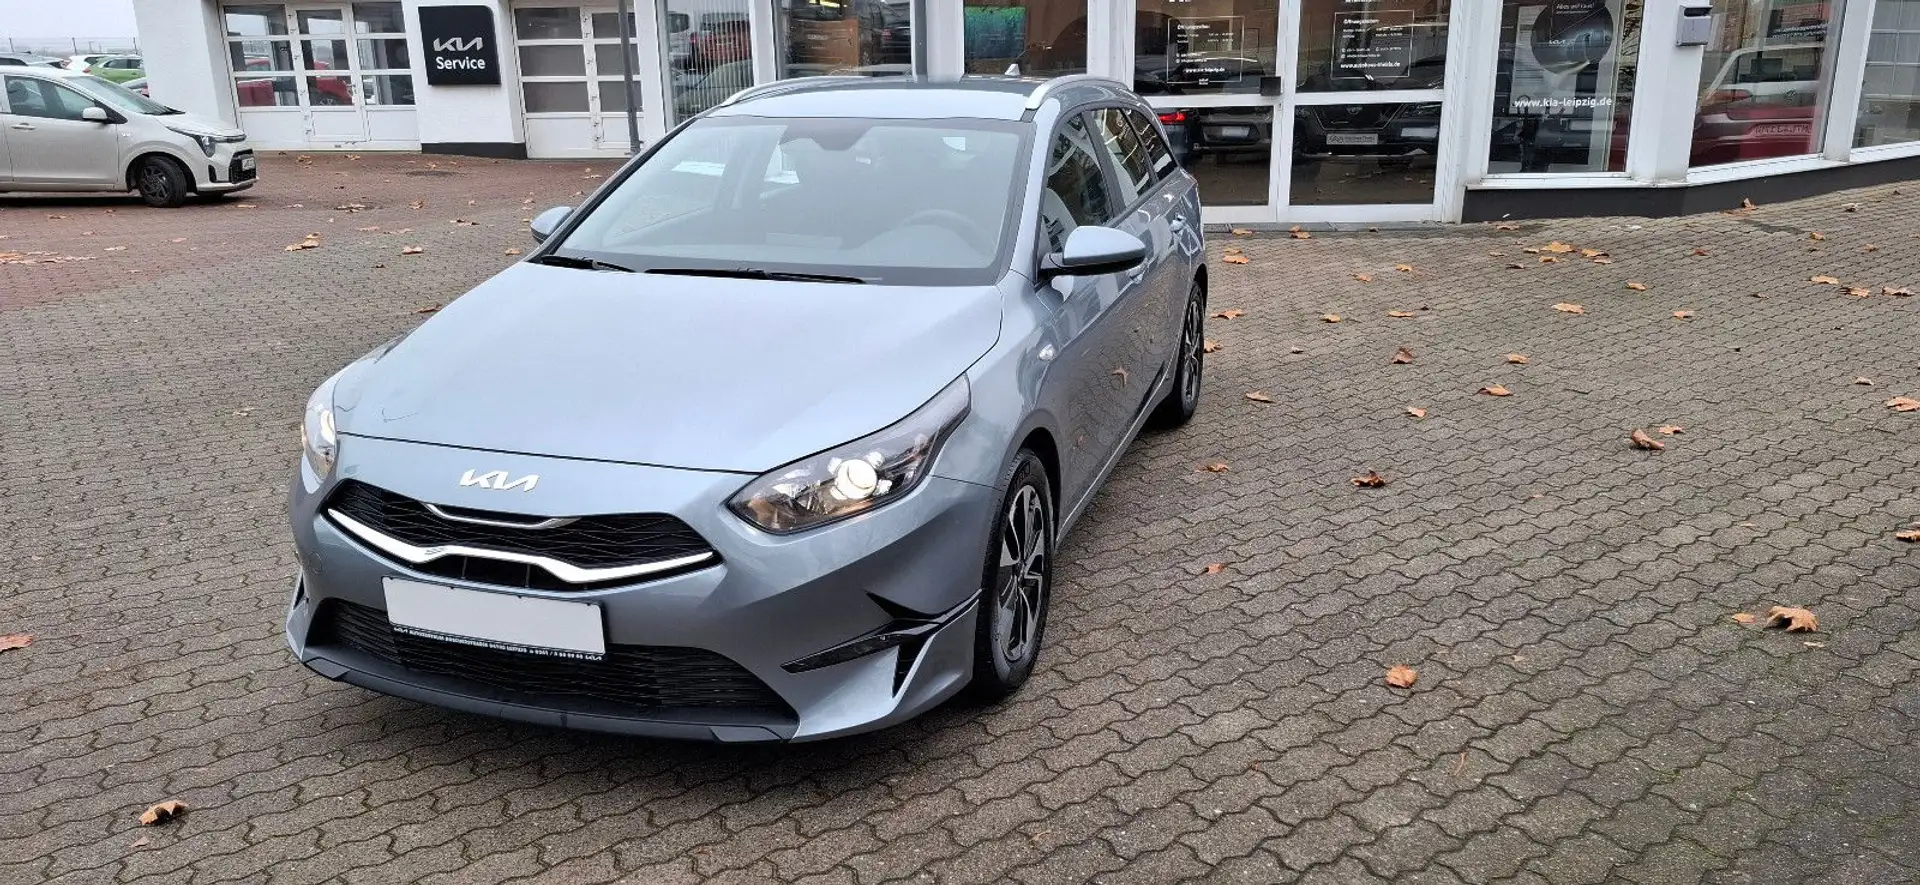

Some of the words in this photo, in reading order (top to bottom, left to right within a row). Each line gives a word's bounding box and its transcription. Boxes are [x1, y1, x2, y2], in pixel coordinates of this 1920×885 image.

[433, 36, 484, 52] KIA
[435, 56, 486, 70] Service
[1513, 96, 1612, 108] www.kia-leipzig.de
[459, 468, 541, 493] KIA
